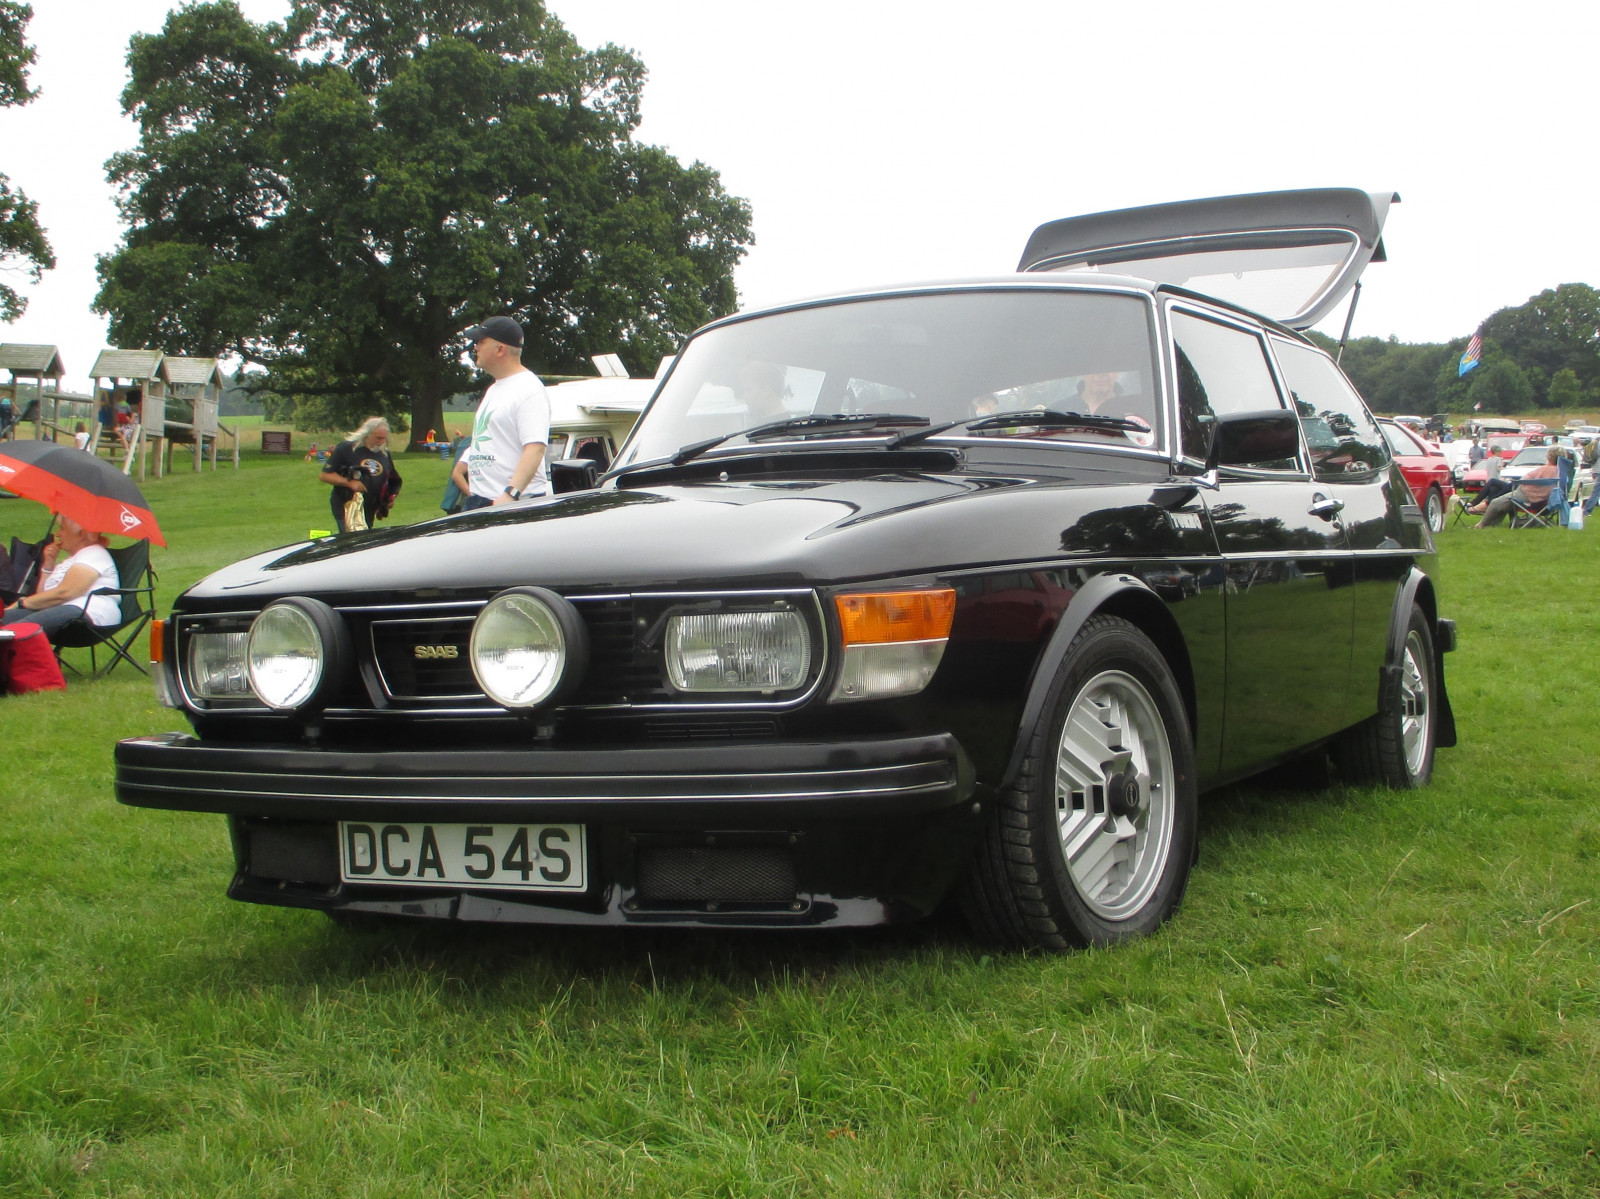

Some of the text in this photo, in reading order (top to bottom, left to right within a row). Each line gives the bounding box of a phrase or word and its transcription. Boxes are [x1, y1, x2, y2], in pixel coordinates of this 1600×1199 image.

[414, 645, 459, 659] SAAB
[347, 824, 572, 882] DCA 54S
